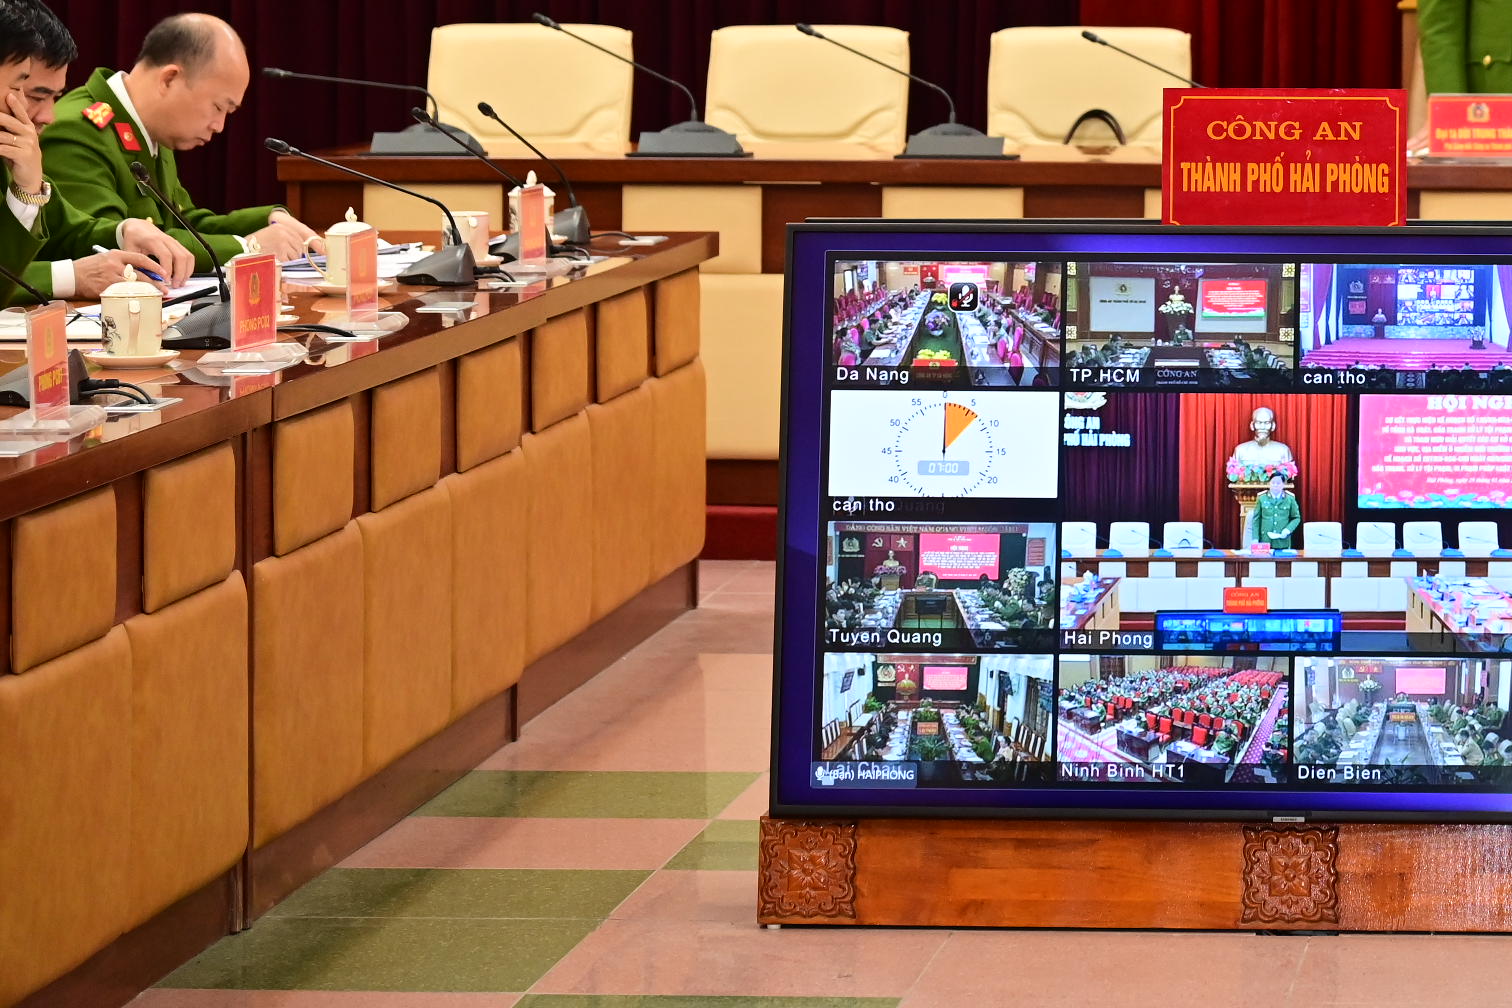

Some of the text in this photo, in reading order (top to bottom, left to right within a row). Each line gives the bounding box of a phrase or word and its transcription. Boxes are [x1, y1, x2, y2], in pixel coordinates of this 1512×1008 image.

[1206, 114, 1363, 140] CÔNG AN
[1180, 150, 1389, 193] THÀNH PHỐ HẢI PHÒNG
[836, 367, 859, 382] Da
[866, 367, 909, 384] Nang
[1070, 368, 1140, 383] TP.HCM
[1303, 371, 1366, 384] can tho
[911, 398, 922, 406] 55
[971, 398, 976, 407] 5
[890, 419, 901, 427] 50
[989, 419, 999, 427] 10
[881, 447, 892, 455] 45
[996, 448, 1006, 456] 15
[928, 462, 959, 474] 07:00
[888, 476, 899, 484] 40
[987, 476, 998, 484] 20
[832, 498, 895, 512] can tho
[829, 629, 942, 645] Tuyen Quang
[1065, 631, 1153, 648] Hai Phong
[1061, 764, 1184, 778] Ninh Binh HT1
[1297, 766, 1381, 779] Dien Bien
